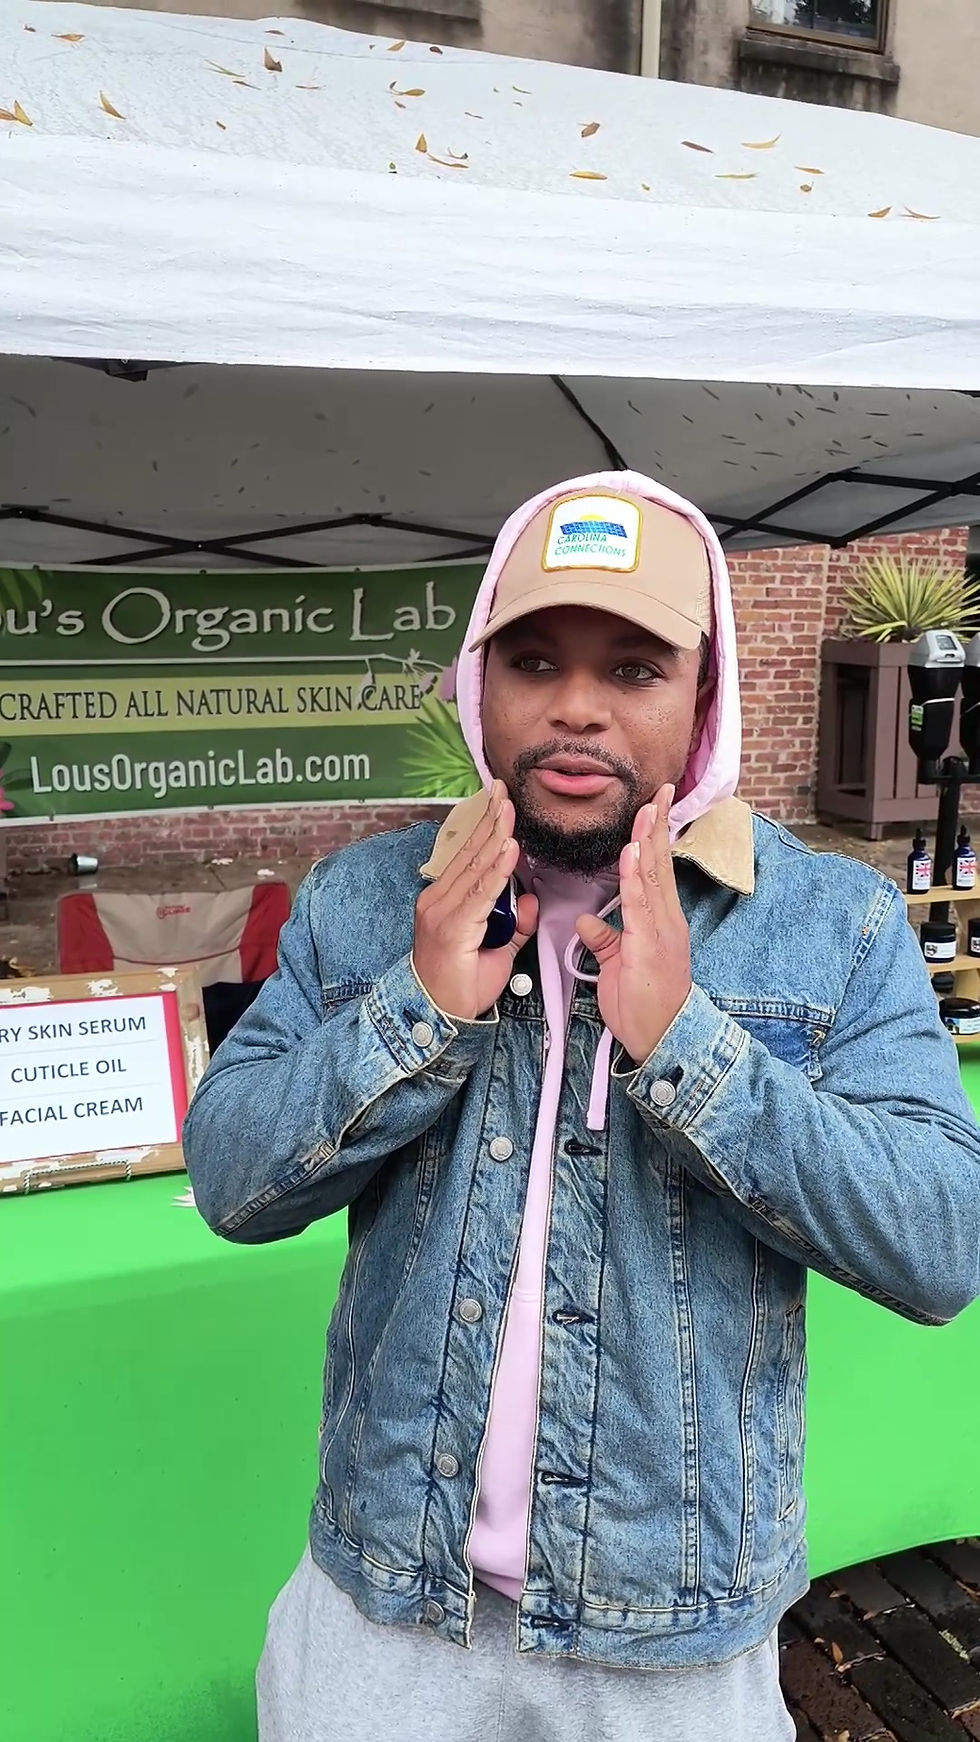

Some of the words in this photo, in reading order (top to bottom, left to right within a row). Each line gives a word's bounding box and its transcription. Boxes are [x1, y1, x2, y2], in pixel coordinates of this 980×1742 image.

[554, 544, 626, 557] CONNECTIONS
[557, 533, 607, 545] CAROLINA
[0, 599, 84, 636] u's
[102, 587, 334, 652] Organic
[349, 581, 457, 642] Lab
[0, 690, 117, 721] CRAFTED
[124, 690, 168, 718] ALL
[176, 687, 290, 716] NATURAL
[296, 686, 353, 713] SKIN
[361, 684, 421, 711] CARE
[30, 748, 371, 799] LousOrganicLab.com
[28, 1022, 72, 1040] SKIN
[79, 1017, 146, 1035] SERUM
[11, 1061, 89, 1084] CUTICLE
[96, 1059, 126, 1074] OIL
[0, 1105, 68, 1126] FACIAL
[74, 1097, 143, 1118] CREAM
